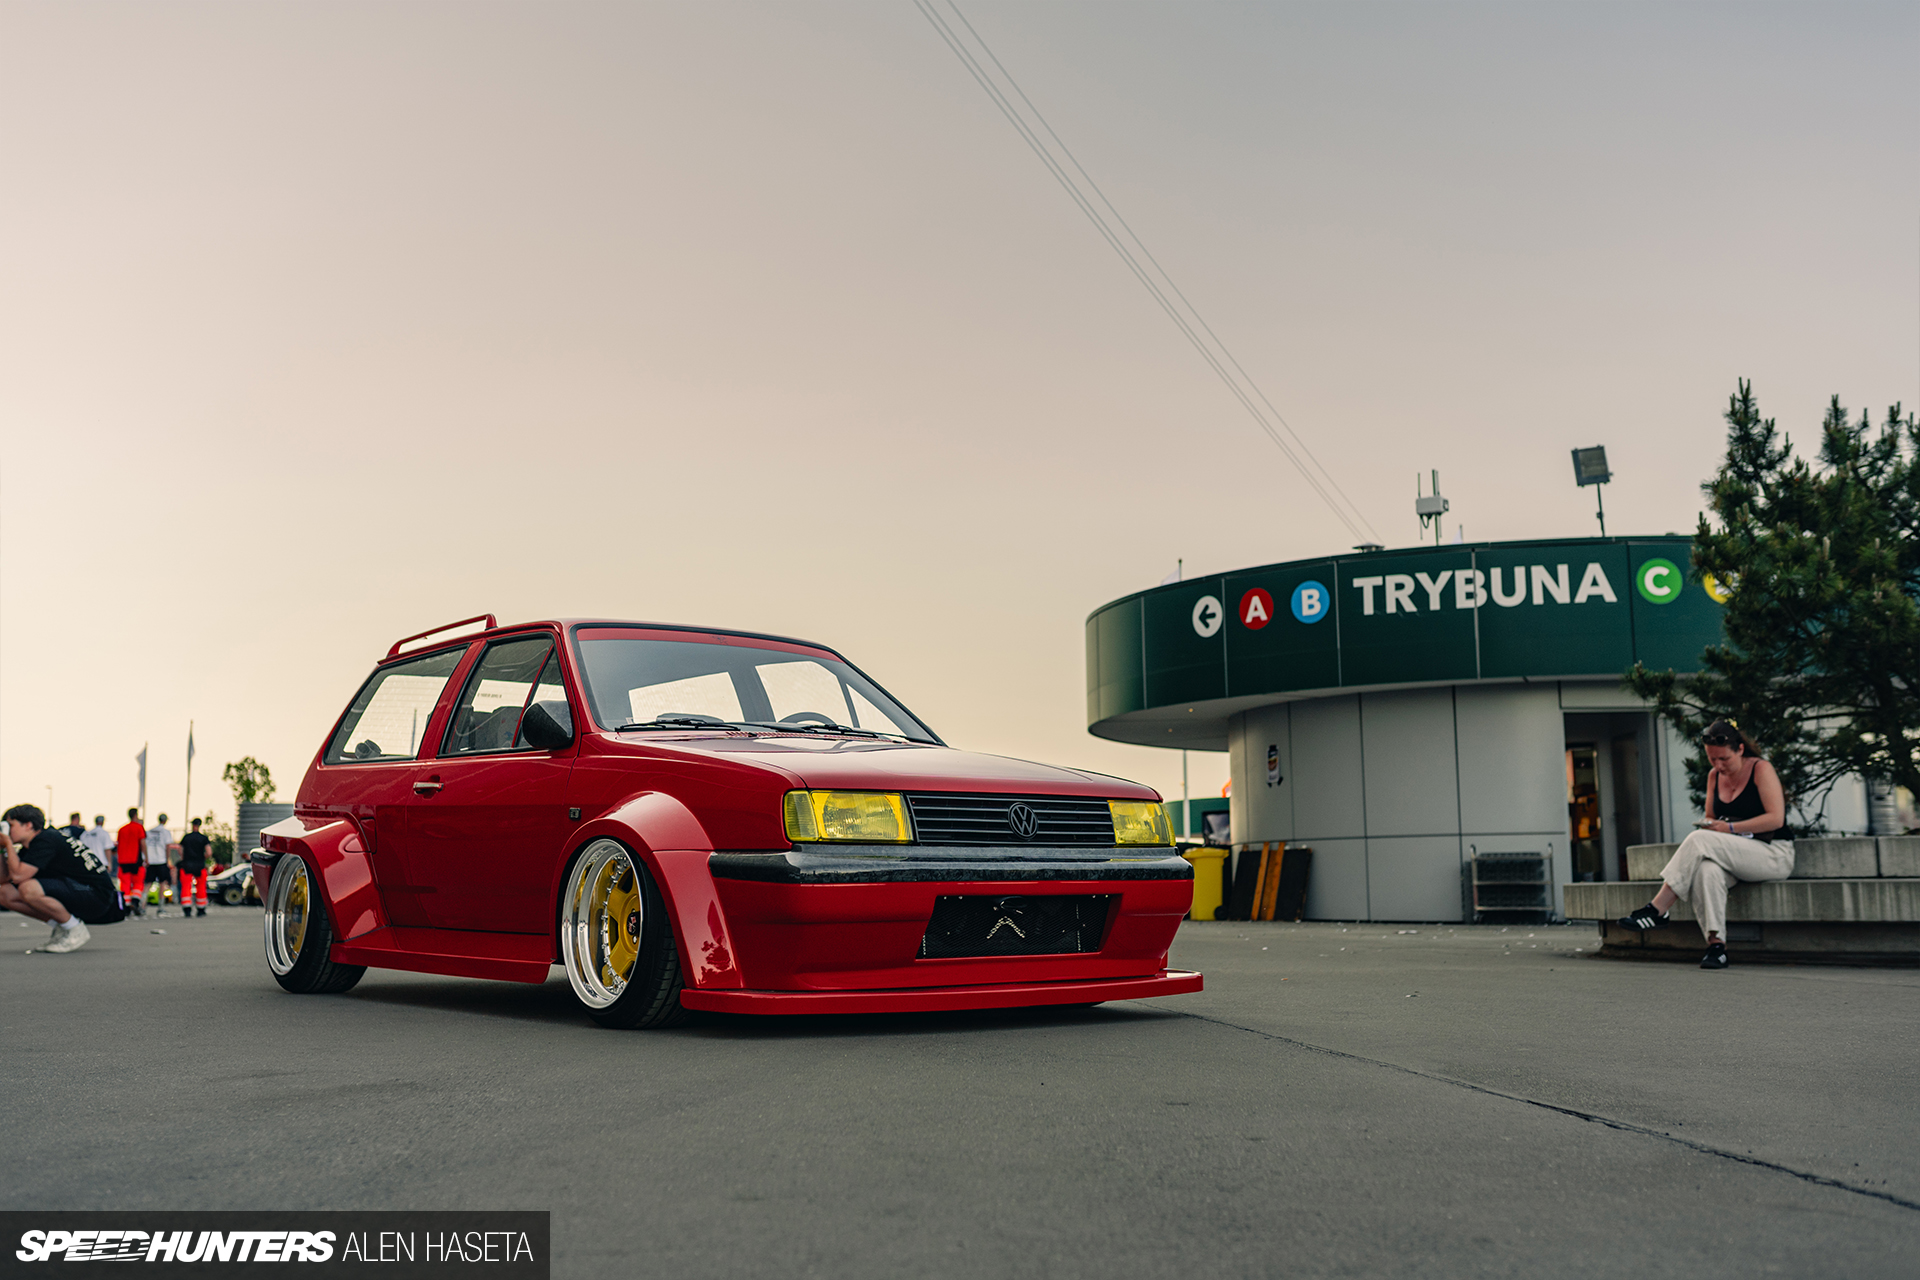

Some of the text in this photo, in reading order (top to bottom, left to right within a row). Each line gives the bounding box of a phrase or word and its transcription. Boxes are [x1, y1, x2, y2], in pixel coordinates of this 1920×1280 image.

[1245, 562, 1672, 623] A B TRYBUNA C
